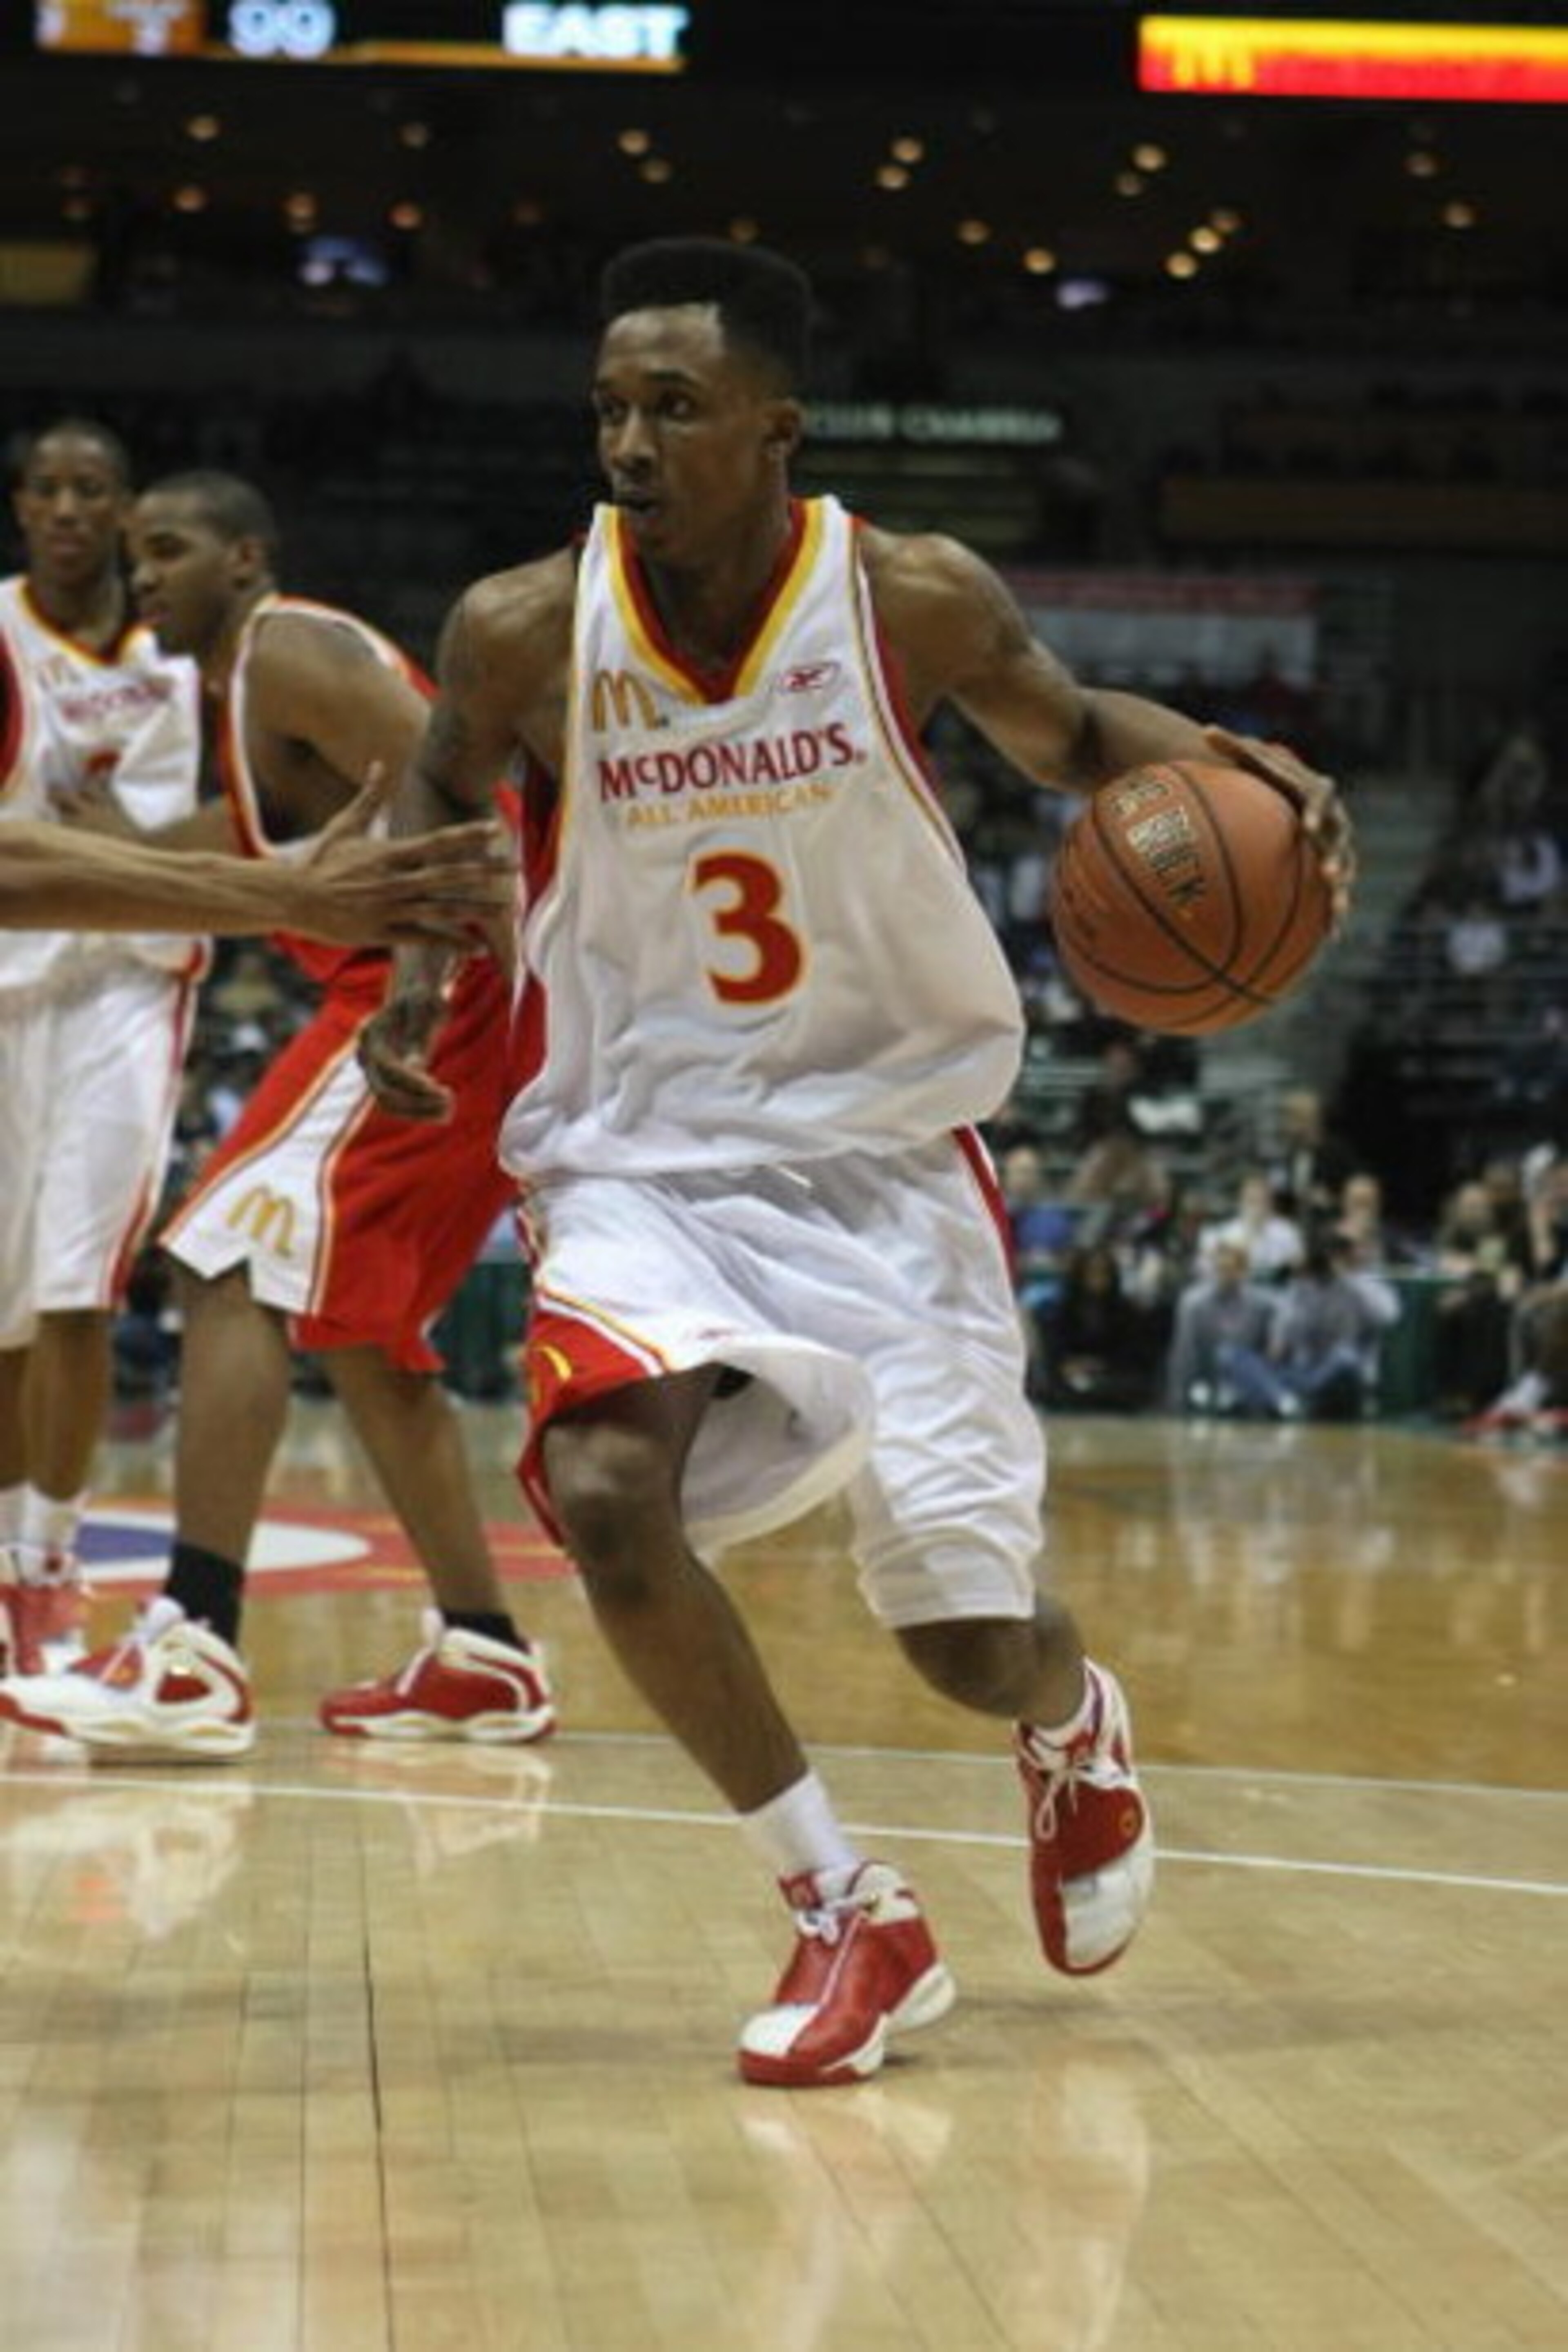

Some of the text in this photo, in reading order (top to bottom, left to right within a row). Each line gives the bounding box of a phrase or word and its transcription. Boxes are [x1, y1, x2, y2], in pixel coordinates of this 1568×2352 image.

[502, 3, 689, 58] EAST
[626, 782, 837, 826] ALL AMERICAN
[688, 849, 808, 1008] 3
